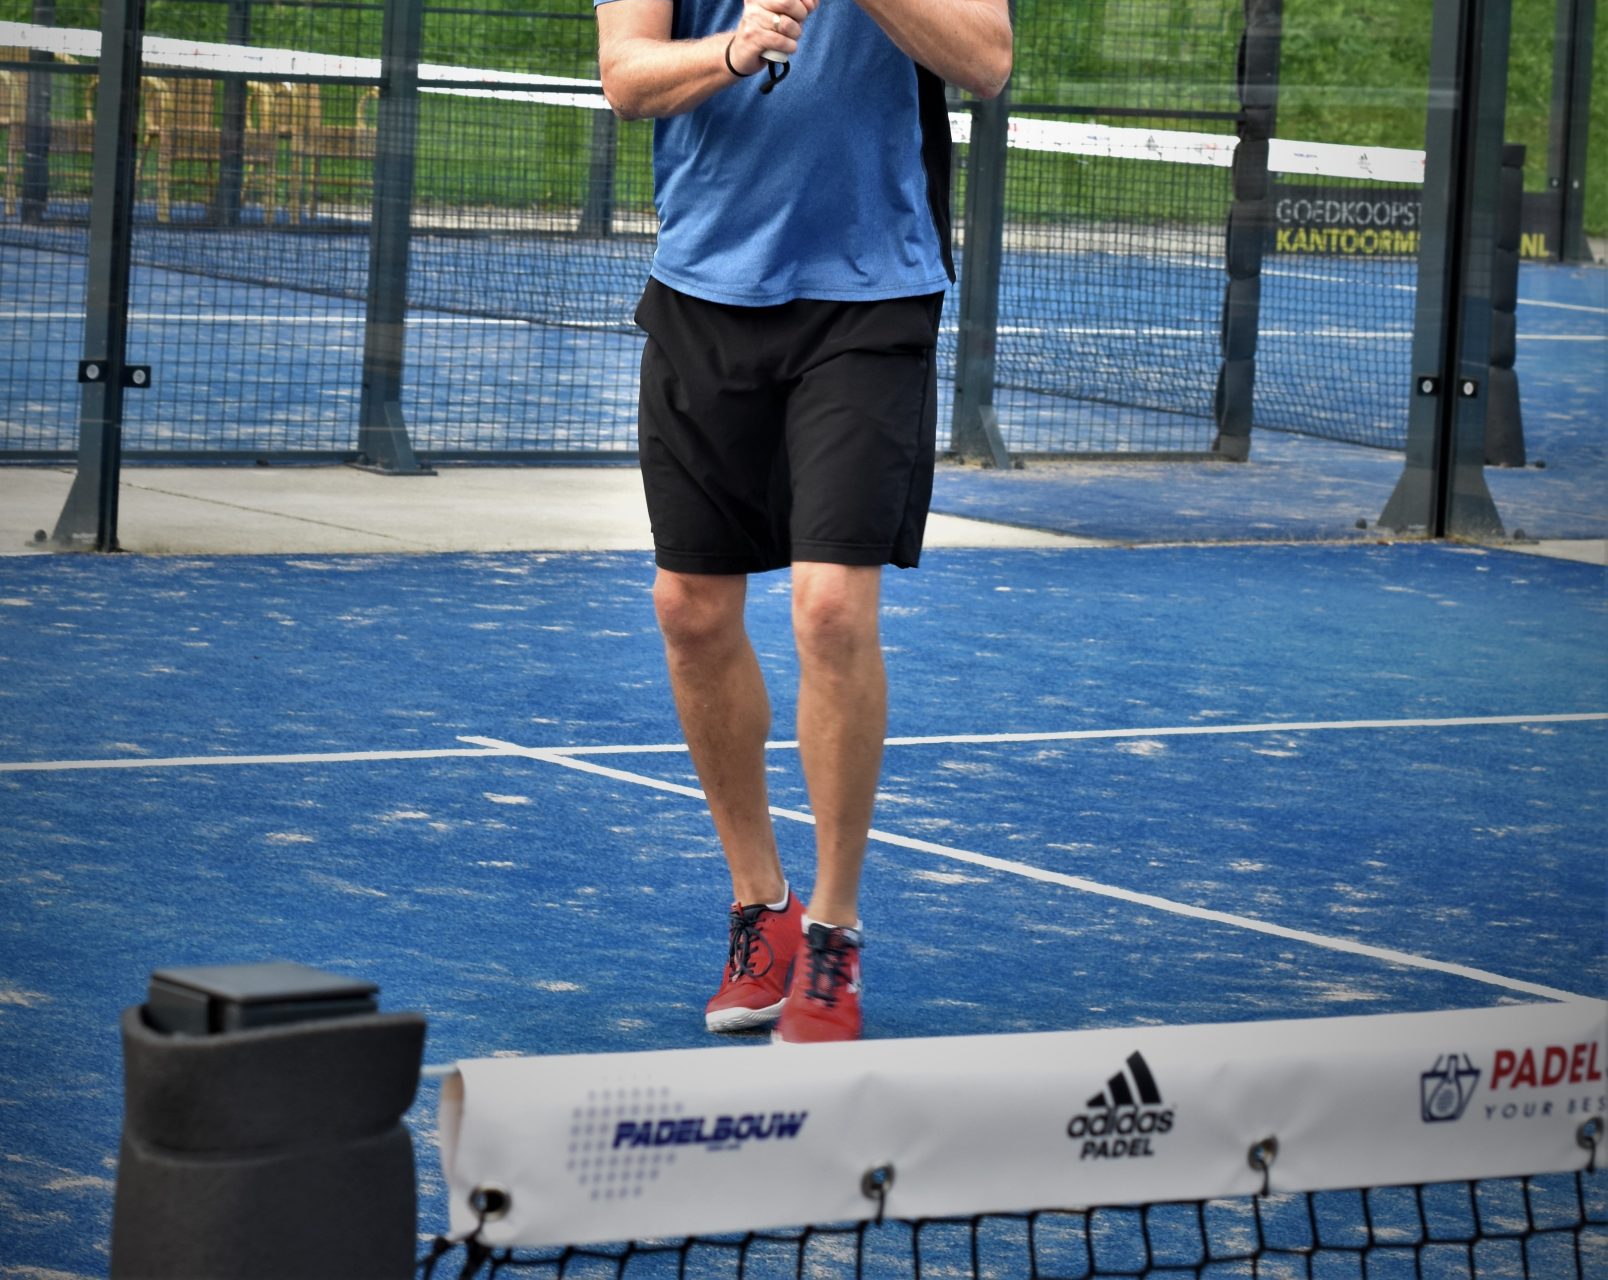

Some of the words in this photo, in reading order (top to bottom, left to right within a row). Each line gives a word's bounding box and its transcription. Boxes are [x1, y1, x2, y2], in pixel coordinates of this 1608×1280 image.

[1275, 228, 1420, 253] KANTOORM
[1490, 1040, 1607, 1091] PADEL
[1067, 1104, 1175, 1138] adidas
[1484, 1102, 1554, 1120] YOUR
[612, 1111, 809, 1150] PADELBOUW
[1080, 1137, 1154, 1160] PADEL
